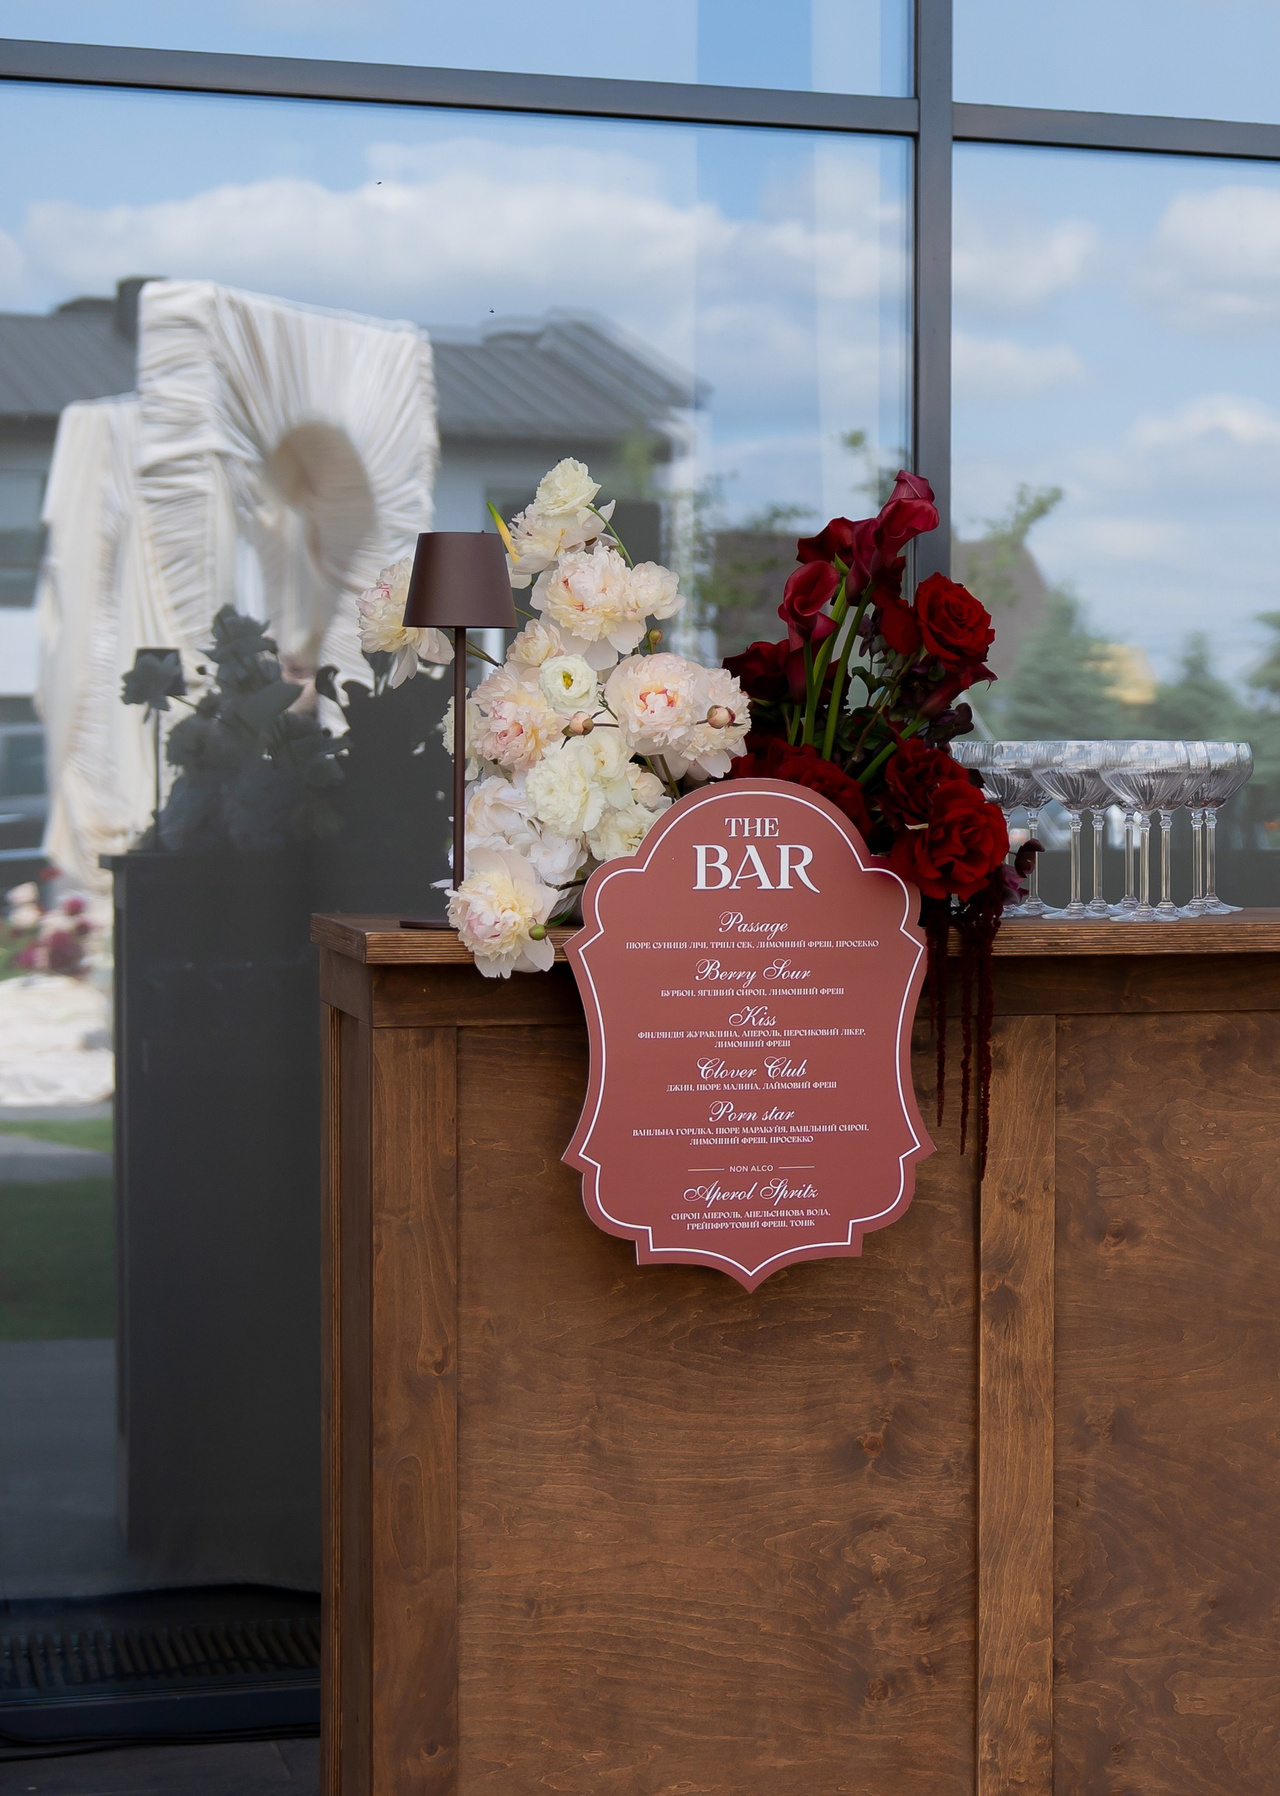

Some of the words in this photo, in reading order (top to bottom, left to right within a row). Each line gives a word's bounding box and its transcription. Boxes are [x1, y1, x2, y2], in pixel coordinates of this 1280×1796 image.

[724, 817, 780, 838] THE
[692, 844, 821, 894] BAR
[718, 911, 789, 940] Passage
[625, 941, 652, 950] ПЮРЕ
[756, 939, 806, 949] ЛИМОННИЙ
[836, 939, 880, 948] ПРОСЕККО
[694, 958, 757, 988] Berry
[762, 958, 811, 981] Sour
[697, 987, 735, 998] ЯГІДНИЙ
[768, 986, 819, 997] ЛИМОННИЙ
[819, 986, 845, 996] ФРЕШ
[728, 1005, 777, 1027] Kiss
[637, 1030, 685, 1039] ФІНЛЯНДІЯ
[783, 1027, 840, 1037] ПЕРСИКОВИЙ
[714, 1039, 765, 1049] ЛИМОННИЙ
[765, 1039, 791, 1048] ФРЕШ
[696, 1057, 757, 1080] Clover
[763, 1056, 808, 1079] Club
[696, 1083, 722, 1092] ПЮРЕ
[762, 1080, 811, 1091] ЛАЙМОВИЙ
[811, 1080, 838, 1090] ФРЕШ
[708, 1100, 758, 1122] Porn
[761, 1105, 795, 1122] star
[632, 1128, 675, 1137] ВАНІЛЬНА
[715, 1126, 741, 1135] ПЮРЕ
[789, 1123, 838, 1133] ВАНІЛЬНИЙ
[689, 1136, 740, 1146] ЛИМОННИЙ
[769, 1135, 815, 1144] ПРОСЕККО
[729, 1165, 749, 1173] NON
[750, 1164, 774, 1173] ALCO
[683, 1180, 758, 1208] Aperol
[759, 1177, 819, 1207] Spritz
[670, 1212, 701, 1221] СИРОП
[743, 1209, 805, 1219] АПЕЛЬСИНОВА
[686, 1219, 760, 1231] ГРЕЙПФРУТОВИЙ
[789, 1218, 816, 1228] ТОНІК
